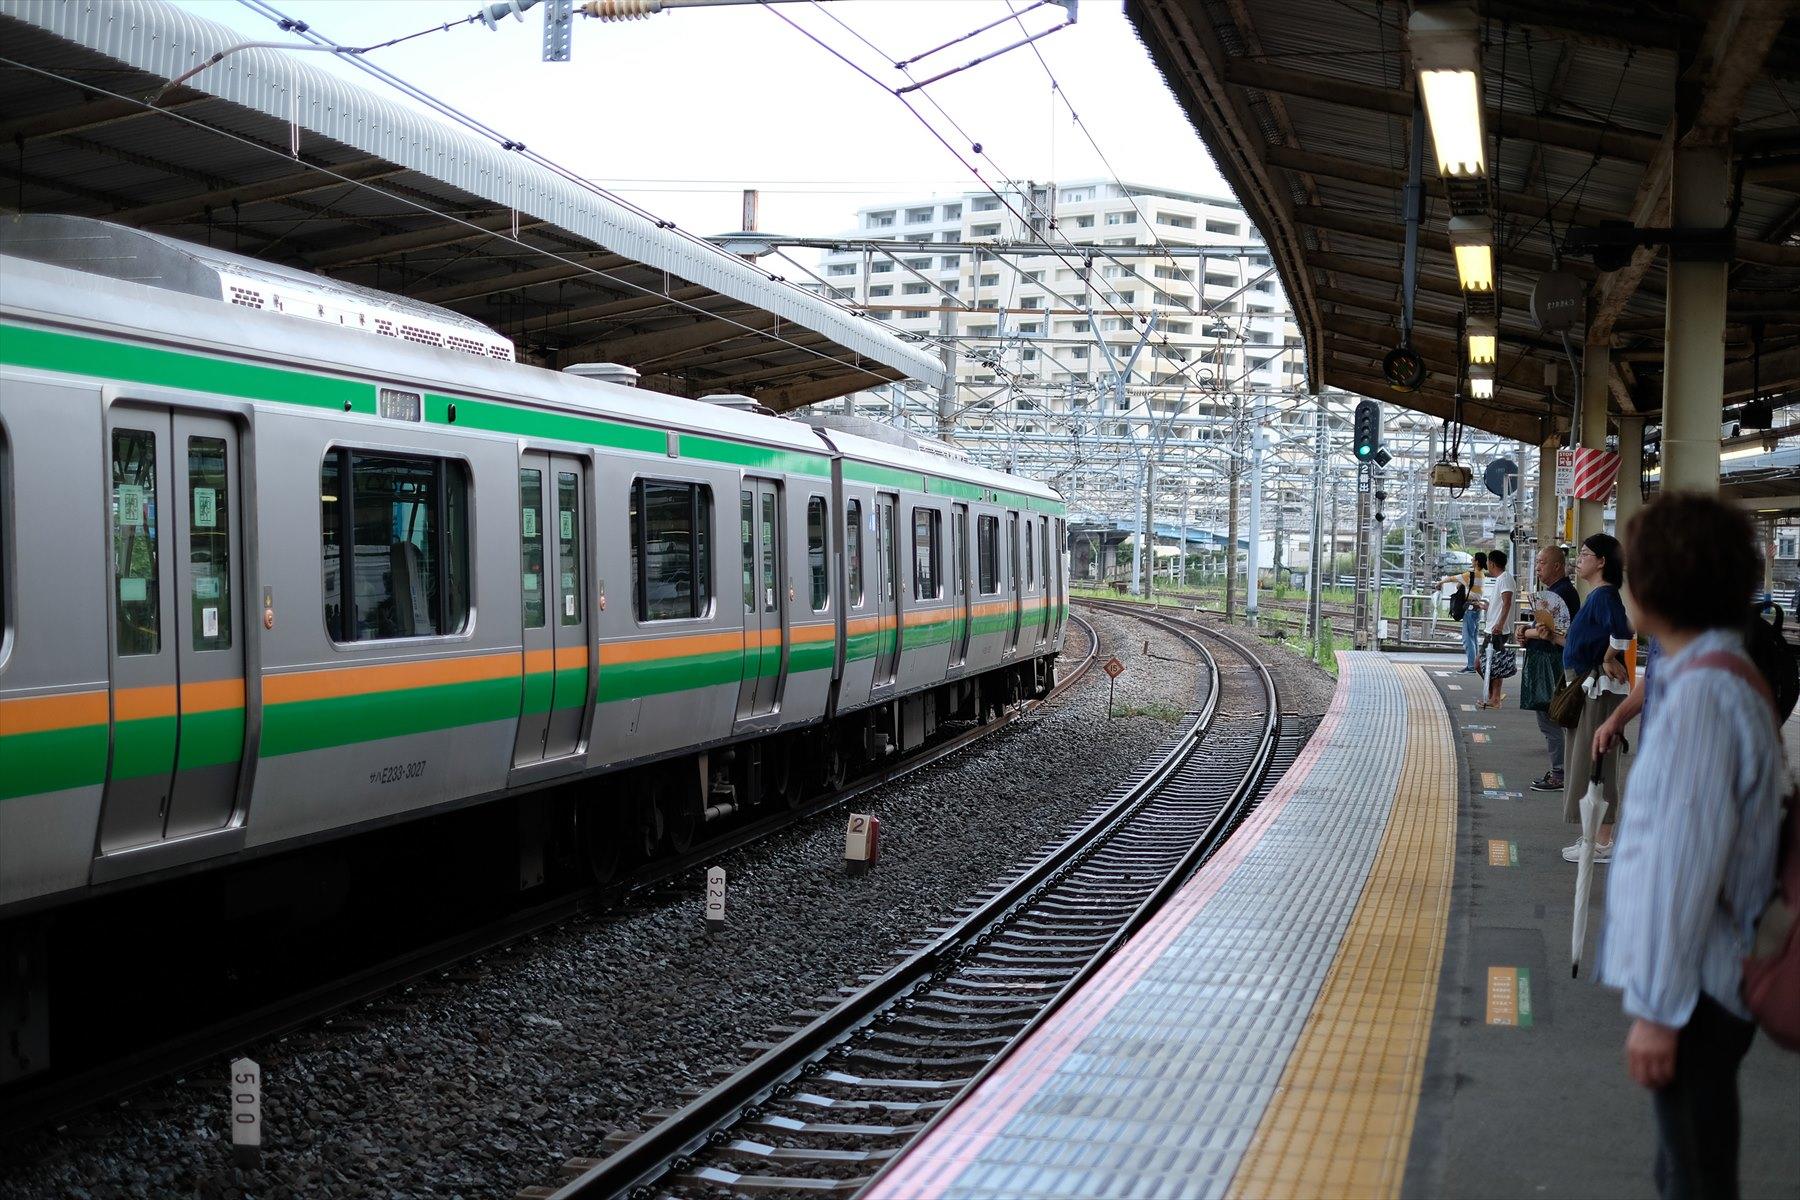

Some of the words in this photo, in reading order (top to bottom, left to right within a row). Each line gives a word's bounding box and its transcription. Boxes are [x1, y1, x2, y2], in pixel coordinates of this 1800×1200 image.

[1110, 664, 1118, 672] 15
[852, 817, 865, 833] 2
[710, 877, 723, 910] 520
[236, 1073, 255, 1124] 500
